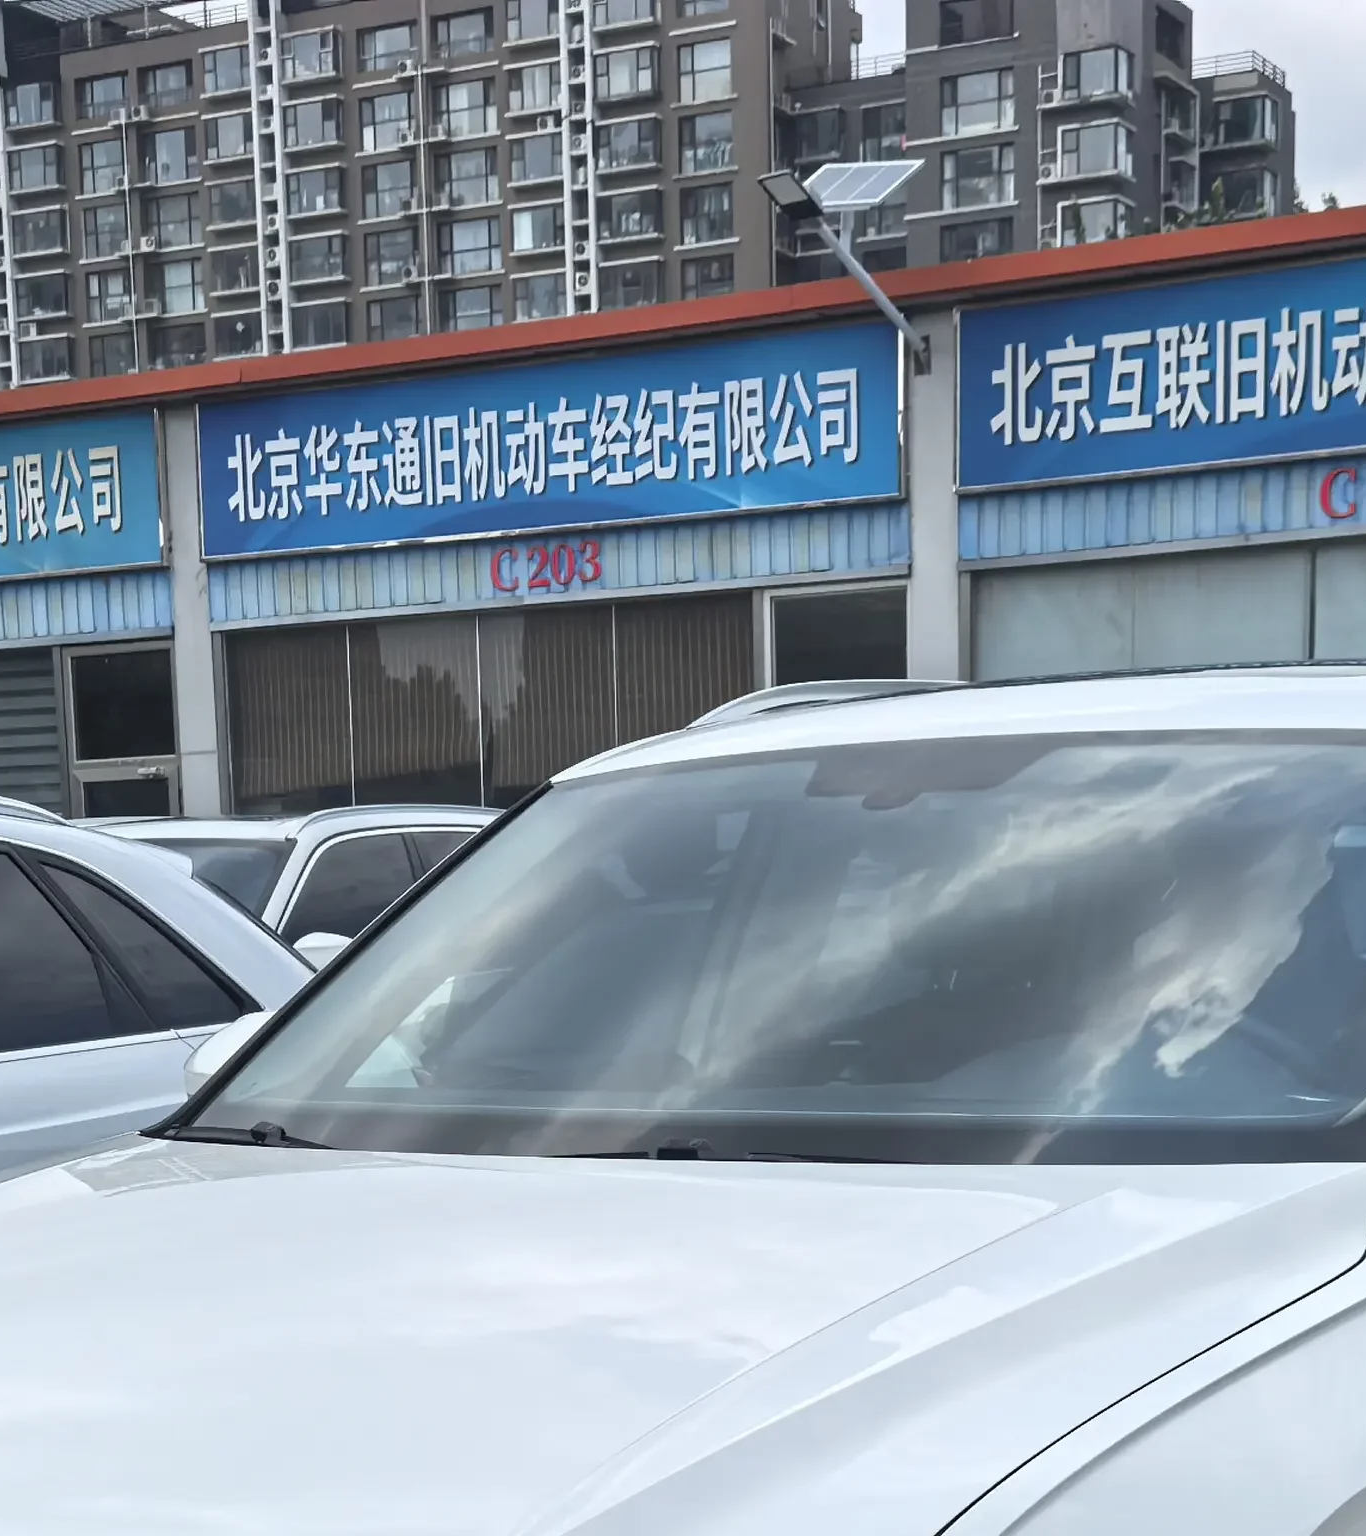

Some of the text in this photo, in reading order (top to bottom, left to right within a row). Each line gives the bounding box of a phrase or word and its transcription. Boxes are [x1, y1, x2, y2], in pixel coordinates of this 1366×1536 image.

[226, 367, 860, 523] 北京华东通旧机动车经纪有限公司
[489, 540, 603, 593] C203
